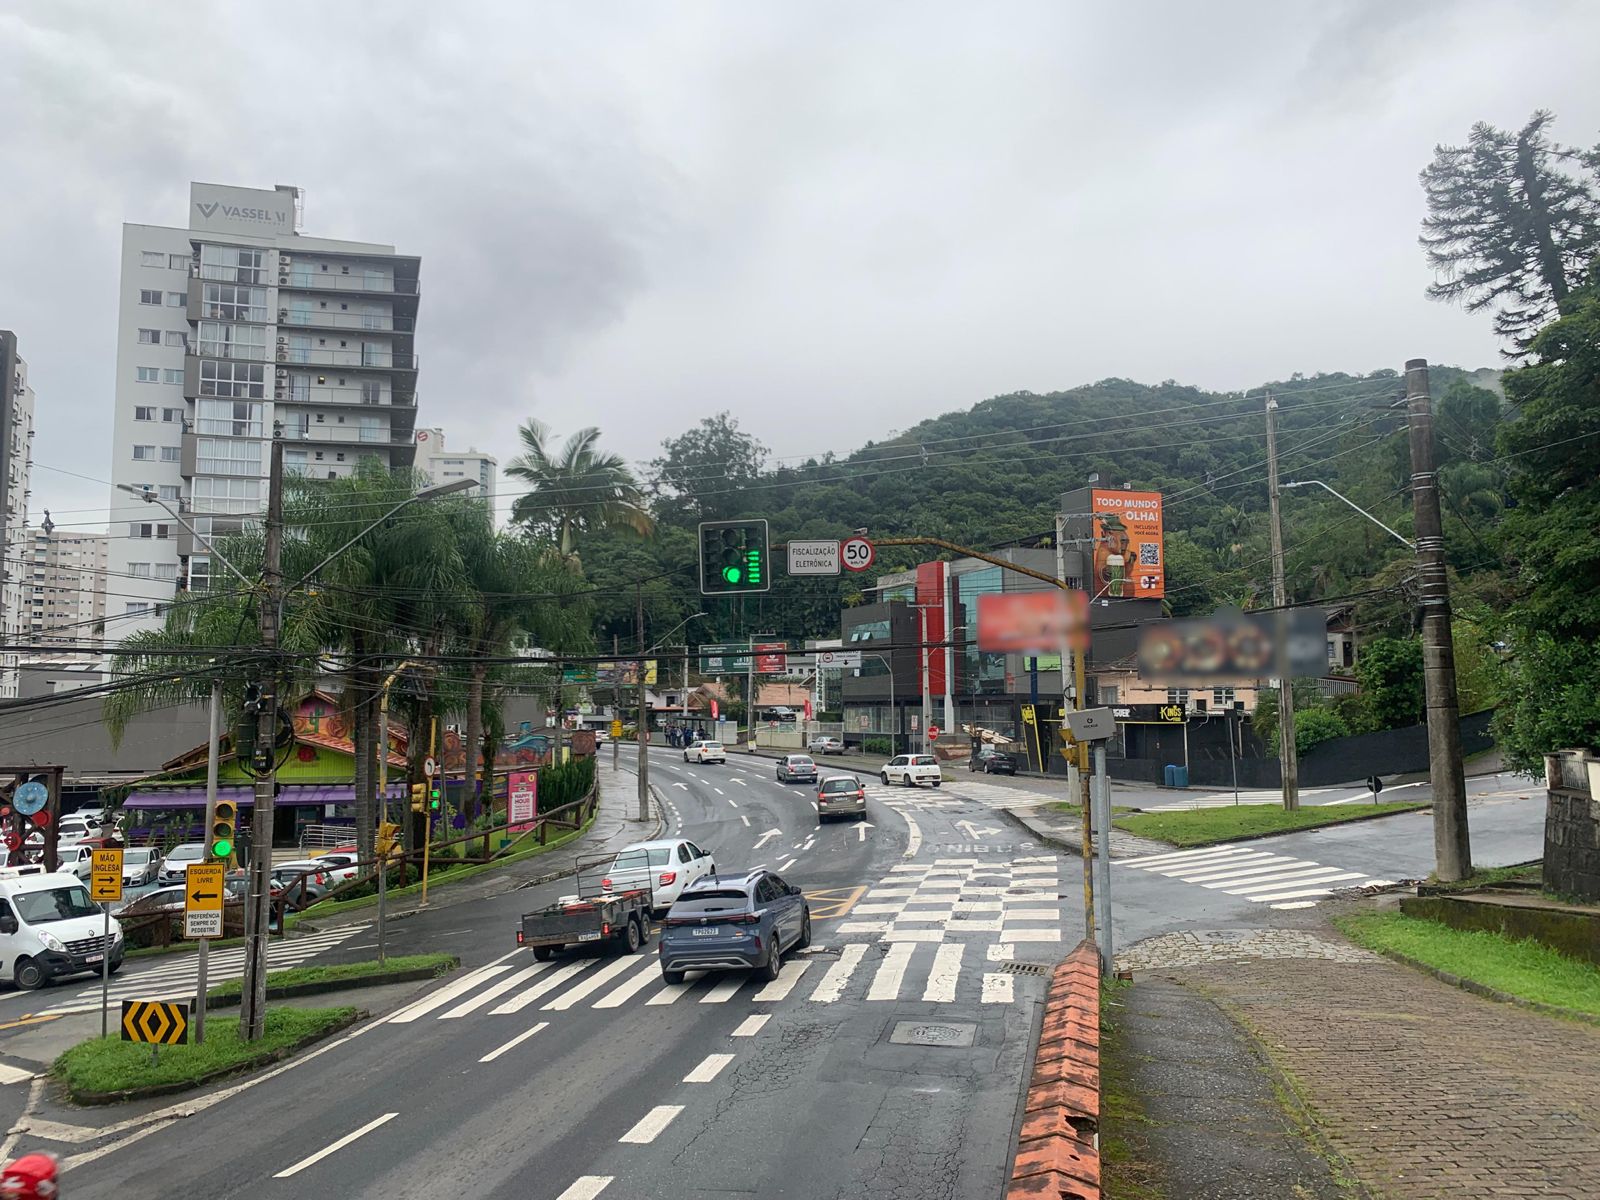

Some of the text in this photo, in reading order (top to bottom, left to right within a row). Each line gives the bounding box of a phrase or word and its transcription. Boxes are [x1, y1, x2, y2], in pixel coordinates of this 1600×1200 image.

[1096, 497, 1158, 509] TODO MUNDO
[1126, 511, 1159, 521] OLHA!
[792, 545, 835, 556] FISCALIZAÇÃO
[847, 544, 869, 560] 50
[795, 559, 833, 568] ELETRÔNICA
[100, 853, 115, 862] MÃO
[94, 864, 120, 872] INGLESA
[188, 912, 220, 920] PREFERÊNCIA
